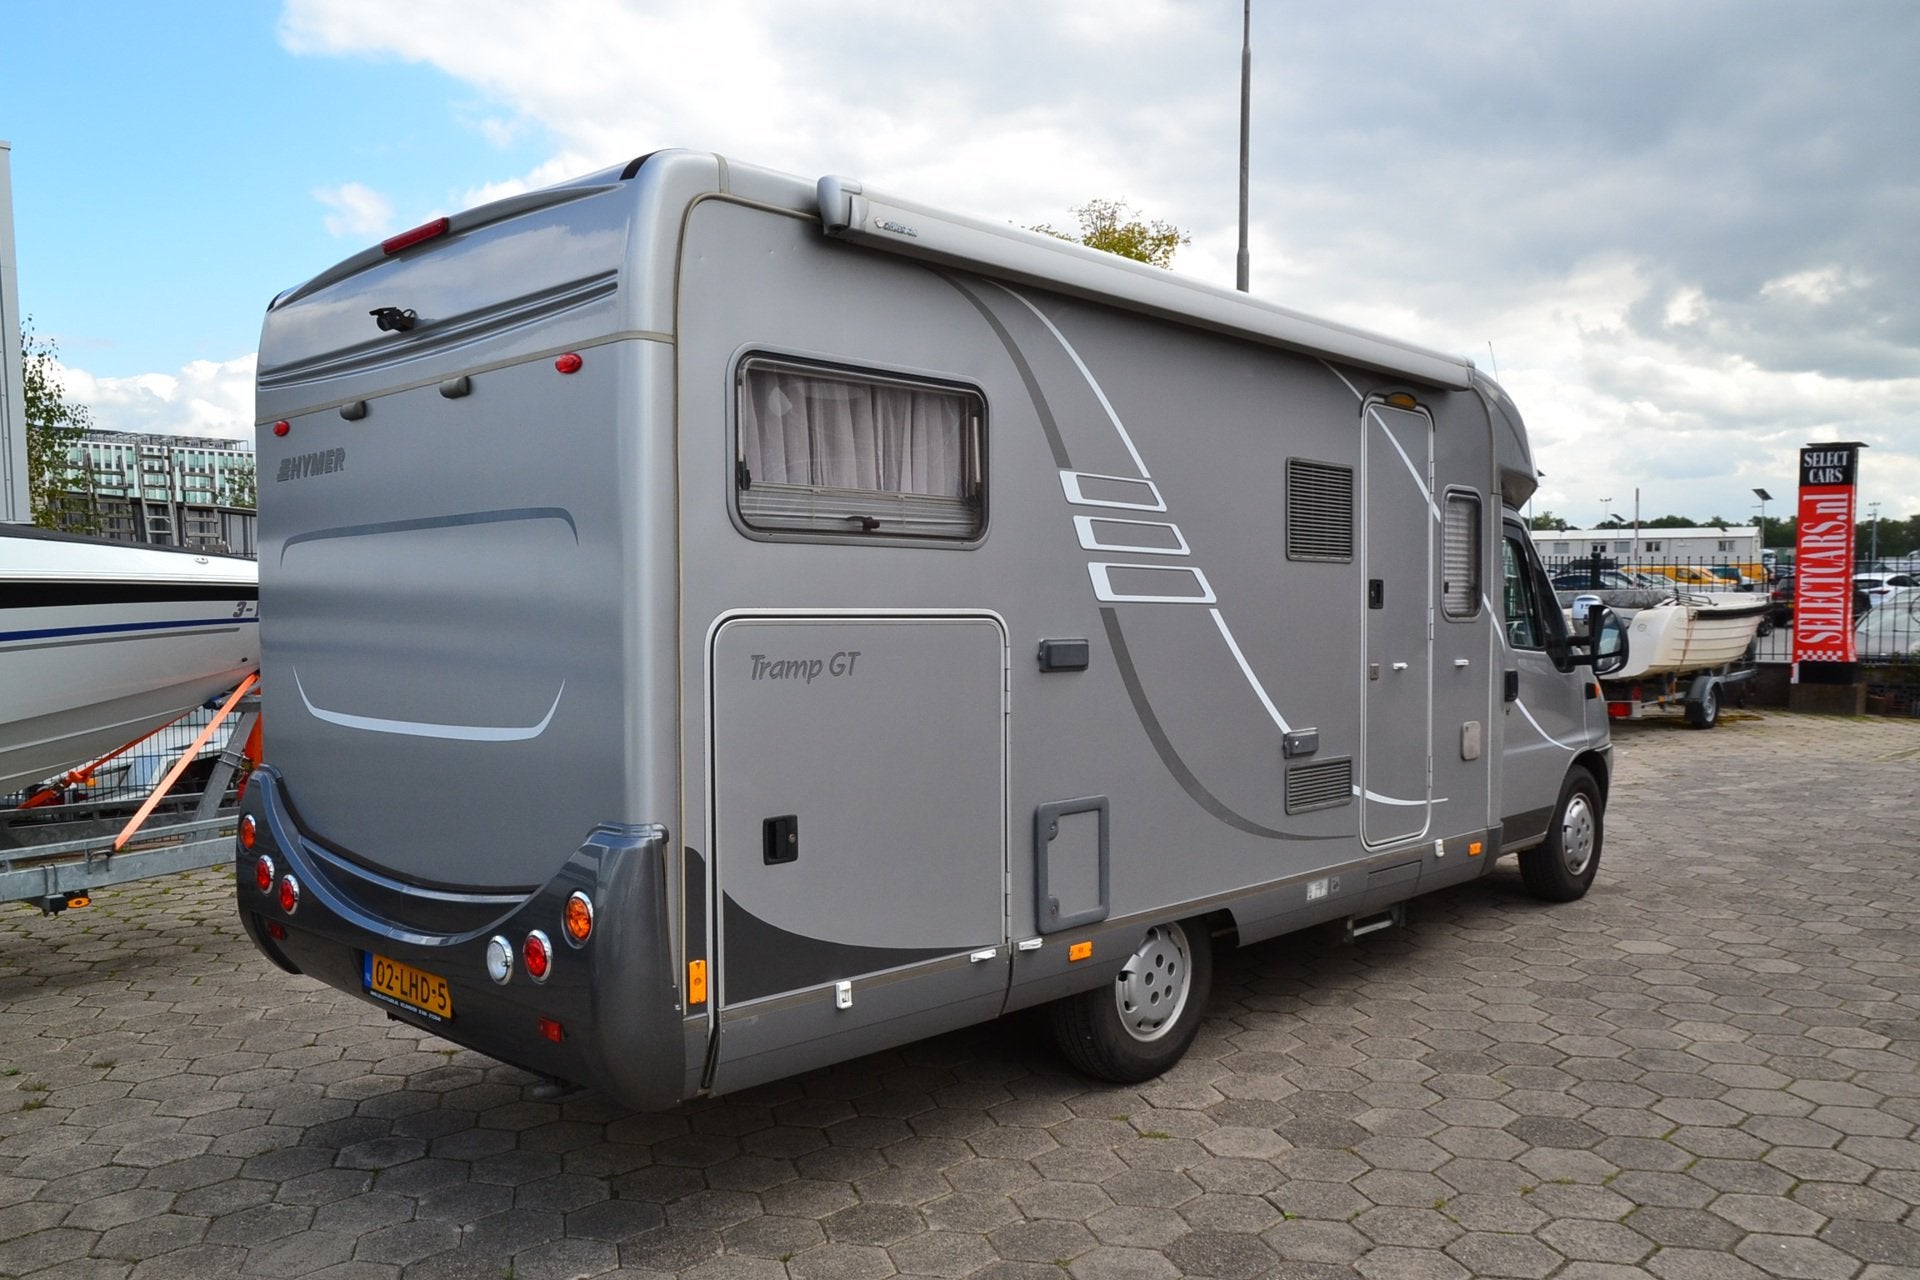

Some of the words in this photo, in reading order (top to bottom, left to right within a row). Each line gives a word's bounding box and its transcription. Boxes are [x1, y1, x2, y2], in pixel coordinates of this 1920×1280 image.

[289, 447, 346, 480] HYMER
[1803, 450, 1849, 468] SELECT
[1809, 467, 1843, 483] CARS
[1798, 493, 1849, 644] SELECTCARS.nl
[751, 654, 823, 685] Tramp
[829, 651, 861, 677] GT
[376, 960, 447, 1011] 02-LHD-5
